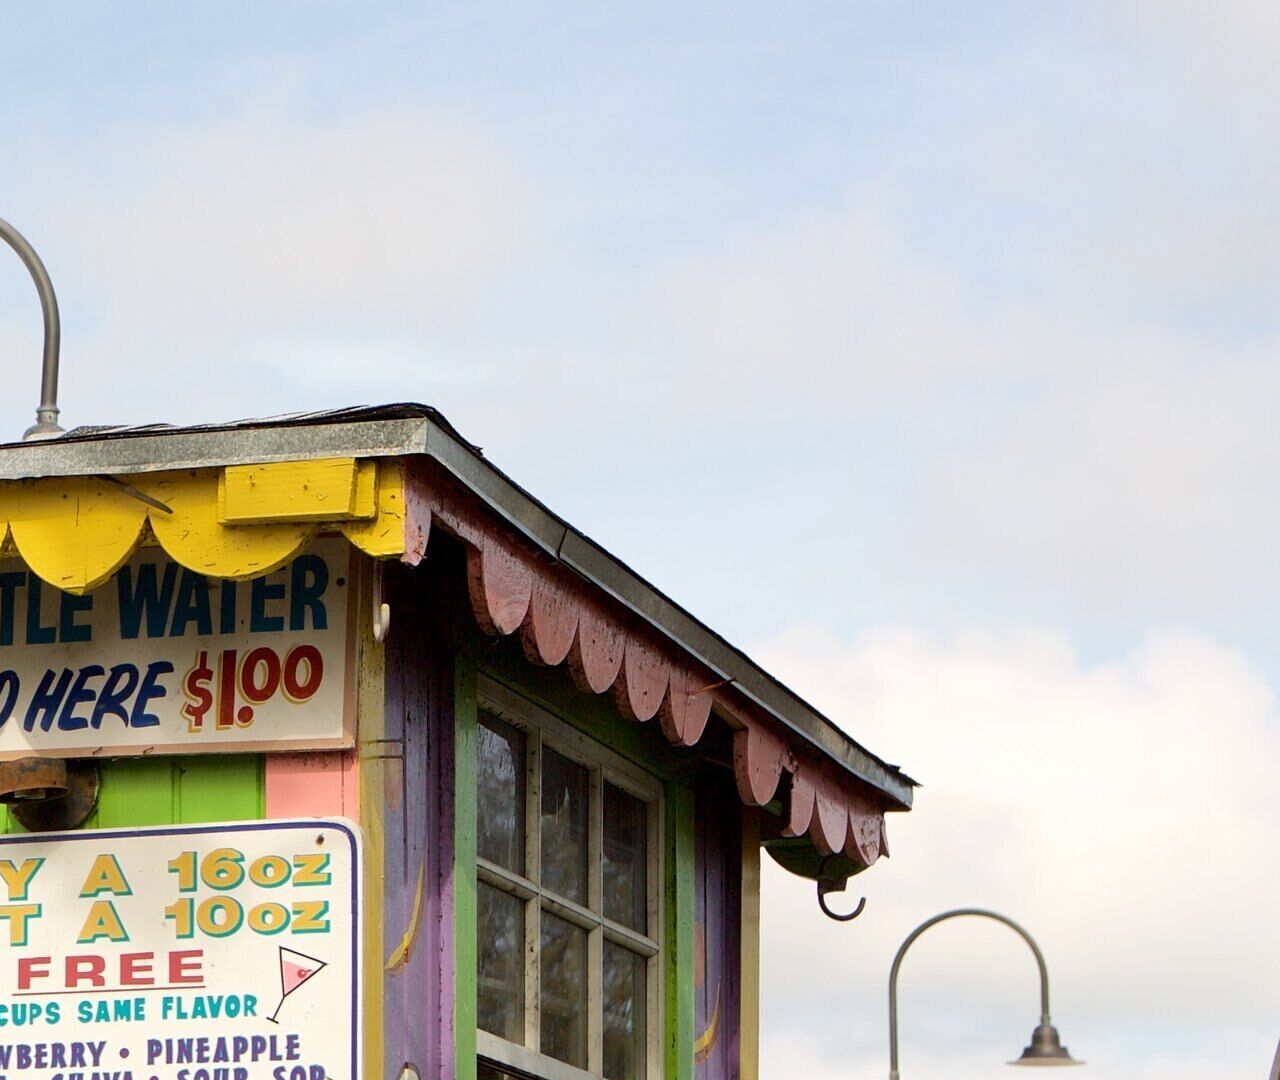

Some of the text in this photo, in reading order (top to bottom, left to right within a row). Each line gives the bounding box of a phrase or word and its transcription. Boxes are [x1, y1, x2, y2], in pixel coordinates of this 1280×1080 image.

[118, 554, 329, 640] WATER
[23, 661, 174, 733] HERE
[181, 644, 325, 734] $1.00
[79, 853, 133, 898] A
[76, 900, 130, 944] A
[17, 950, 204, 990] FREE
[78, 998, 145, 1023] SAME
[162, 994, 258, 1021] FLAVOR
[147, 1034, 300, 1065] PINEAPPLE
